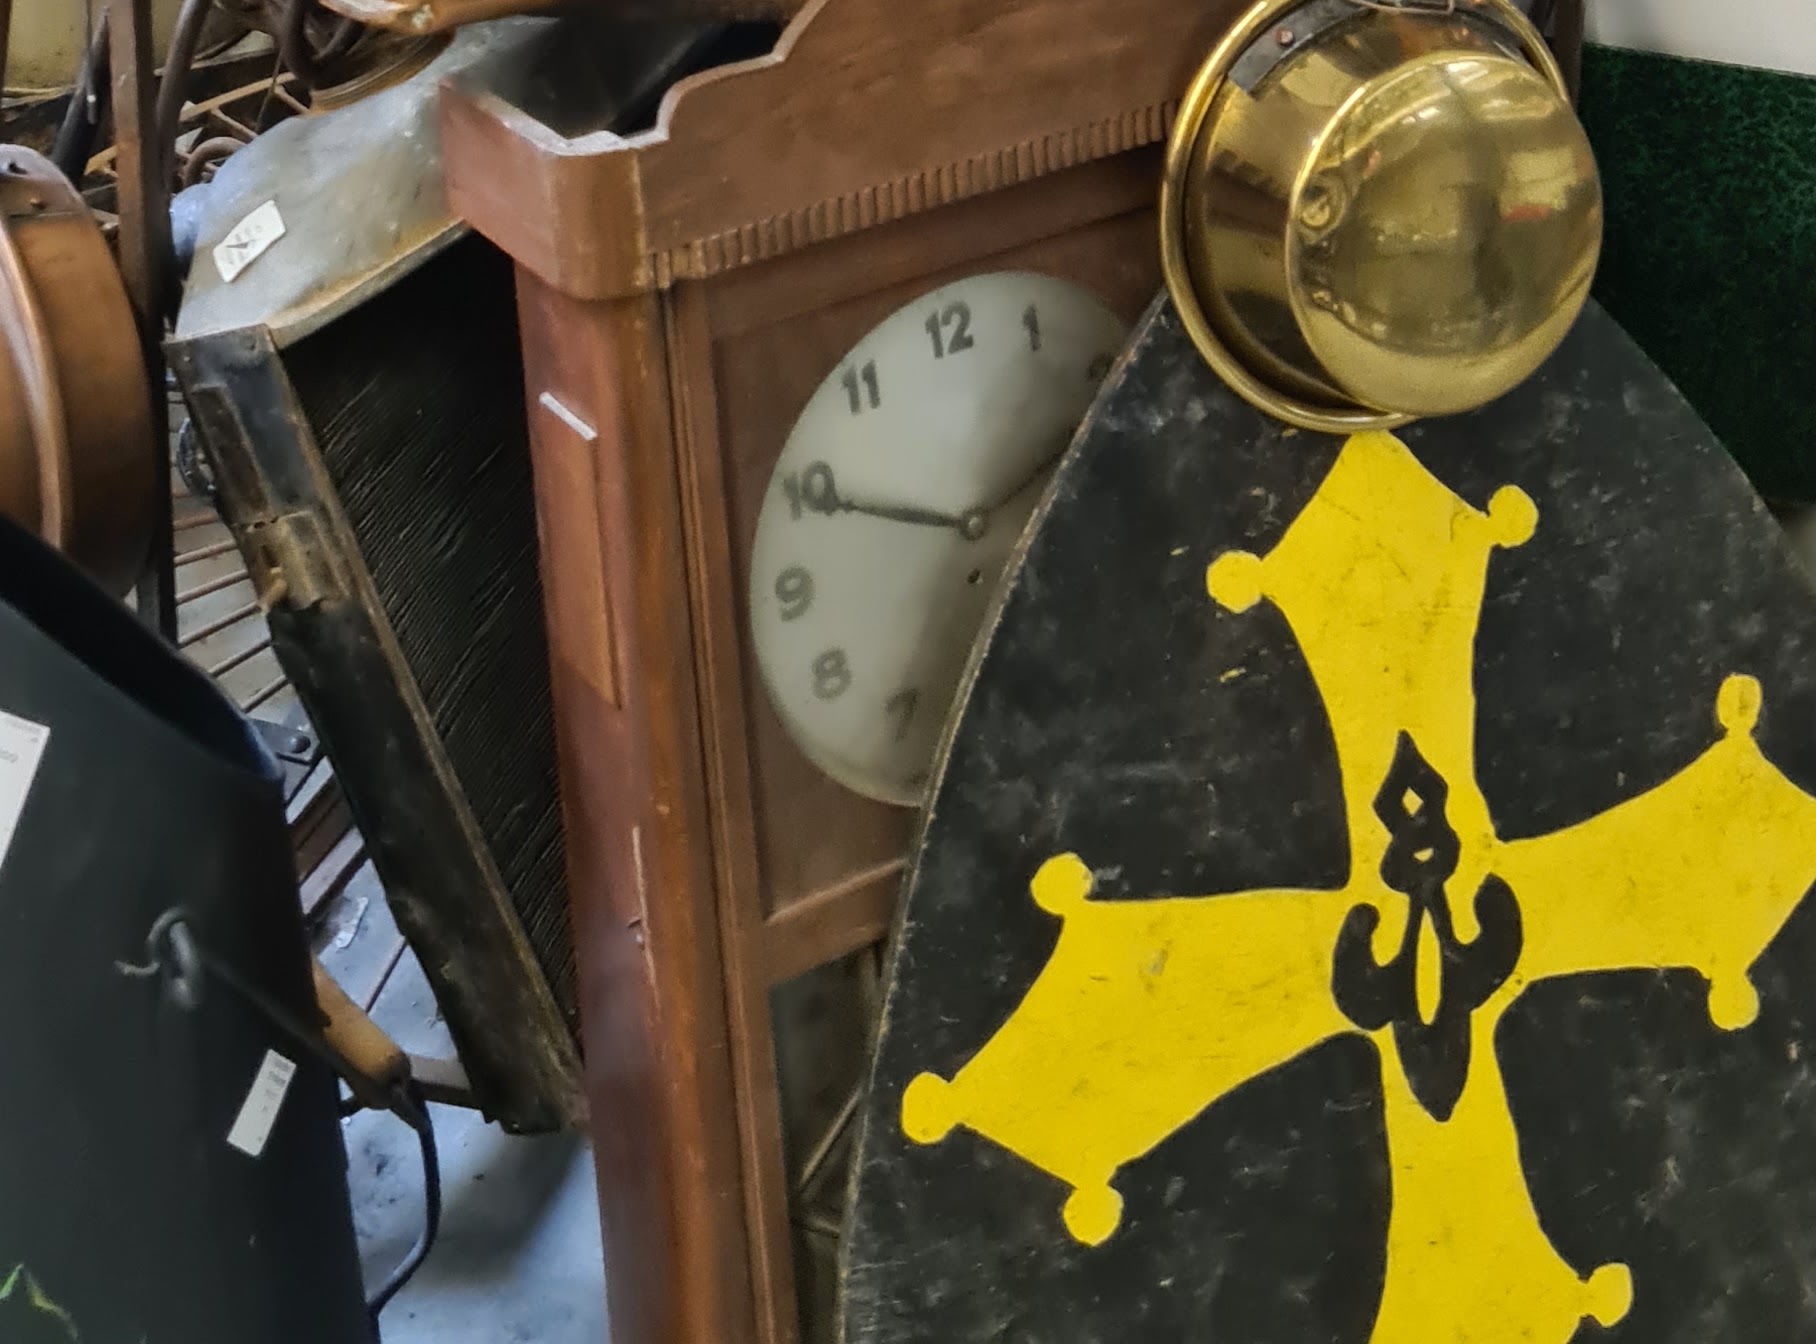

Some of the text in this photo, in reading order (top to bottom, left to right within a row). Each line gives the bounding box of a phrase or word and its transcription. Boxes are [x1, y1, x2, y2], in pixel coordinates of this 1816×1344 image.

[924, 300, 974, 359] 12
[1022, 304, 1042, 351] 1
[841, 359, 881, 415] 11
[782, 459, 839, 520] 10
[774, 565, 815, 622] 9
[811, 647, 852, 700] 8
